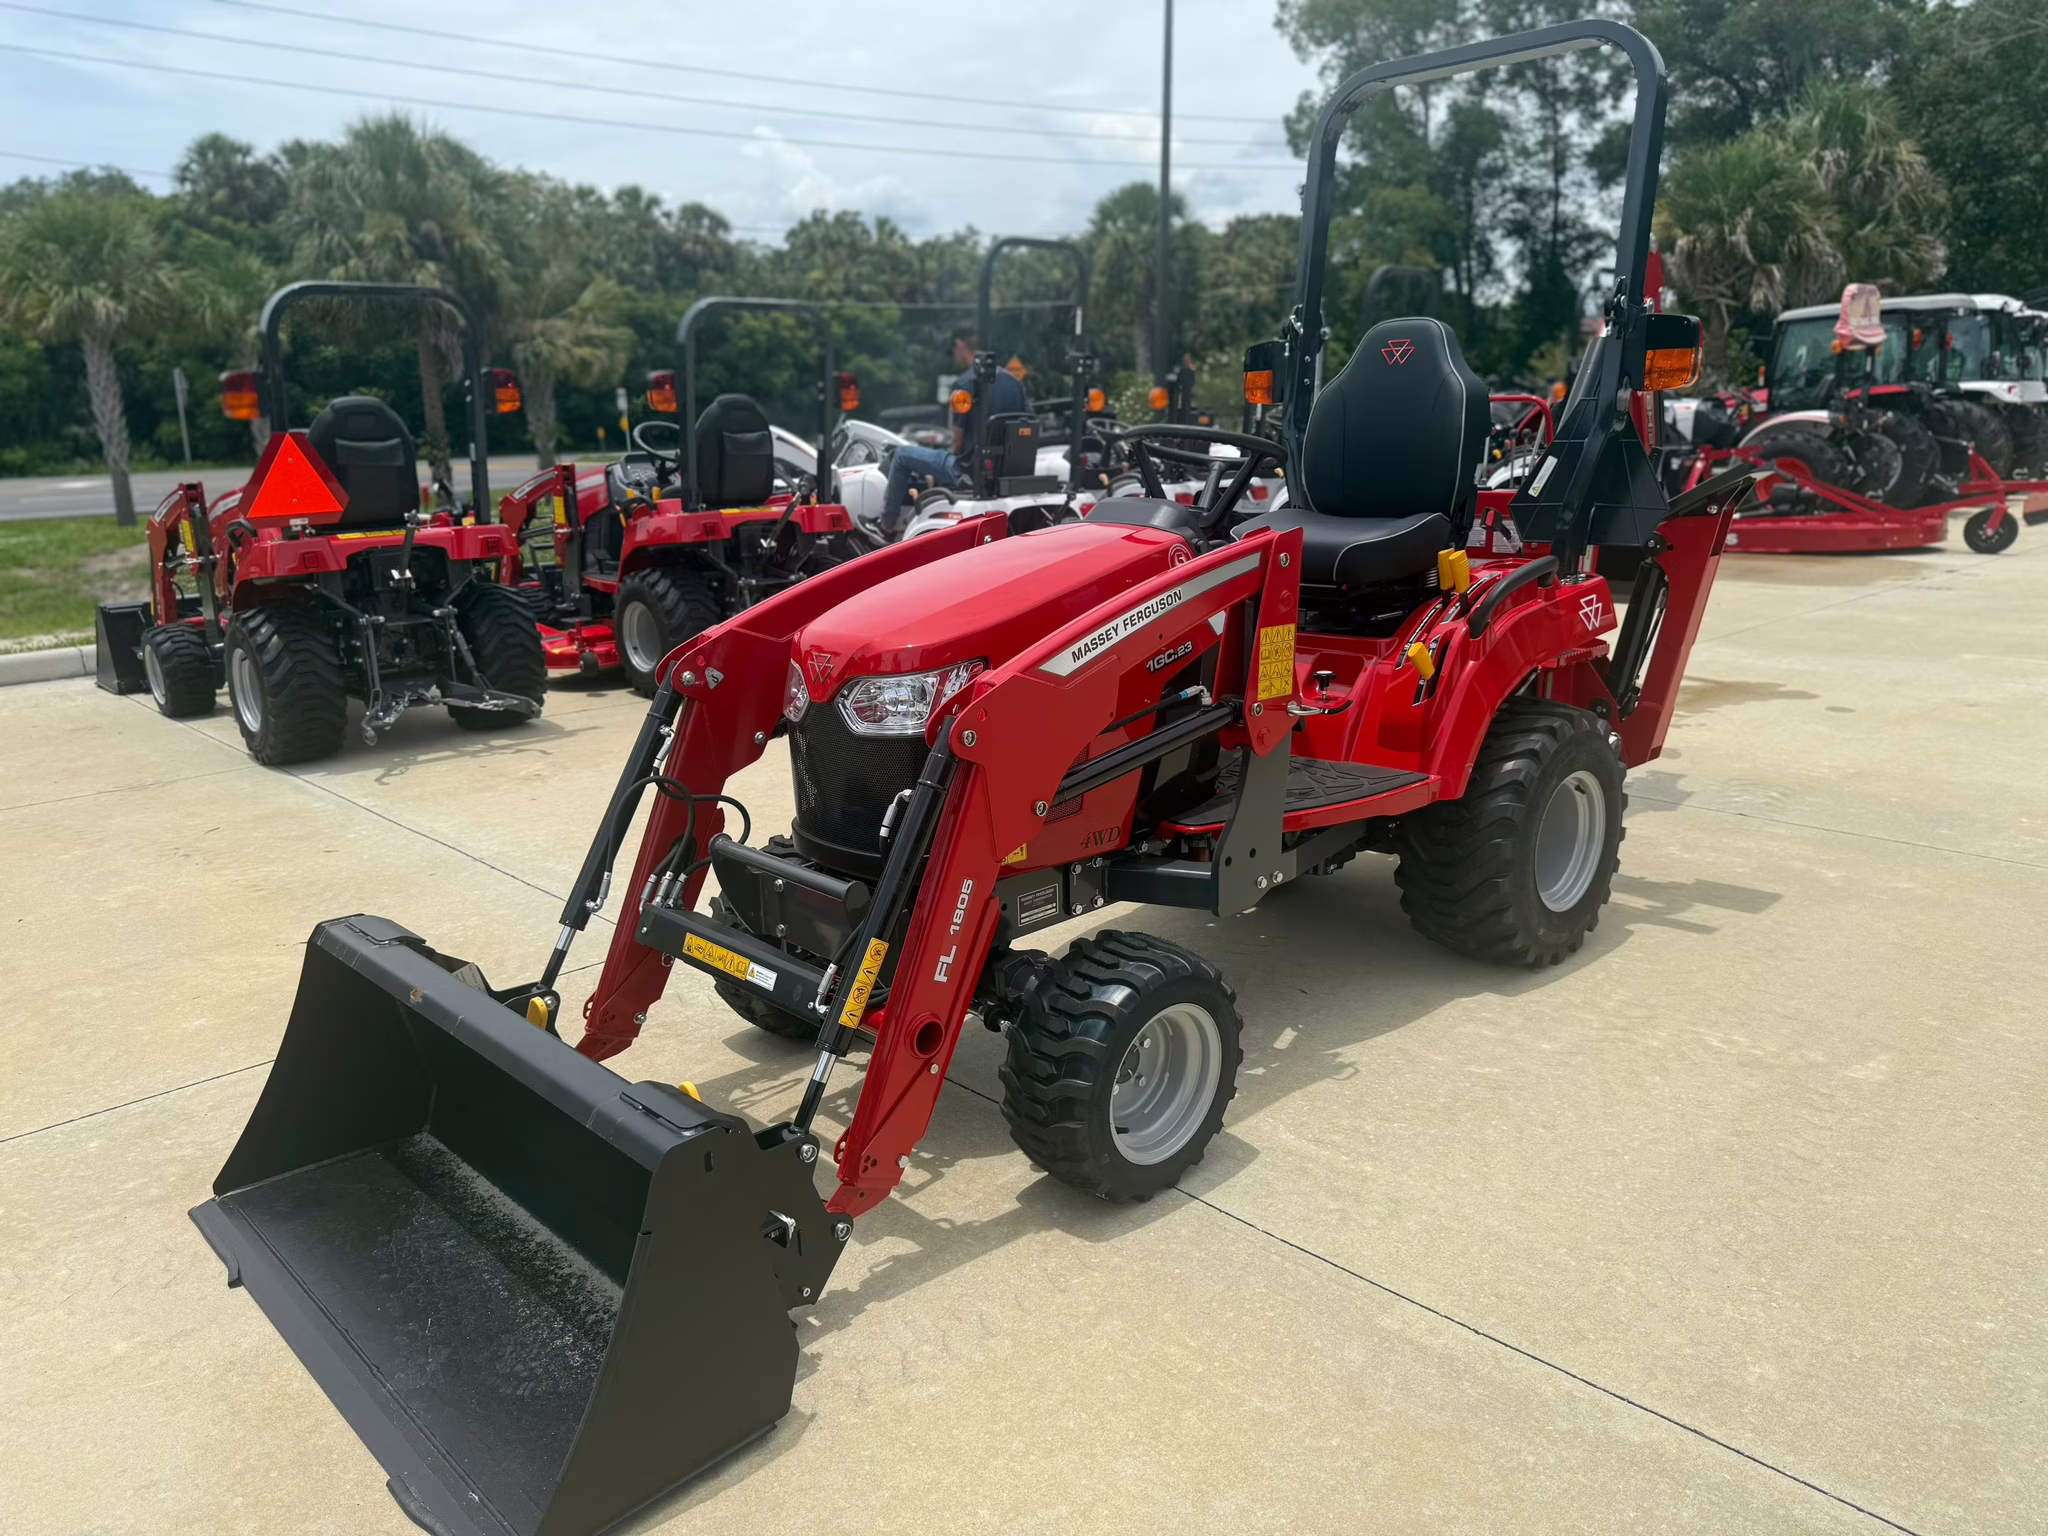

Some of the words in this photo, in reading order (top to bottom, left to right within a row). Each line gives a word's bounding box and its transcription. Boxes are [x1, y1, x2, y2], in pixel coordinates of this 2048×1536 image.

[1071, 623, 1119, 663] MASSEY
[1122, 589, 1183, 631] FERGUSON
[1146, 640, 1193, 672] 1GC.23
[1080, 826, 1122, 850] 4WD
[933, 945, 957, 983] FL
[949, 878, 973, 936] 1805
